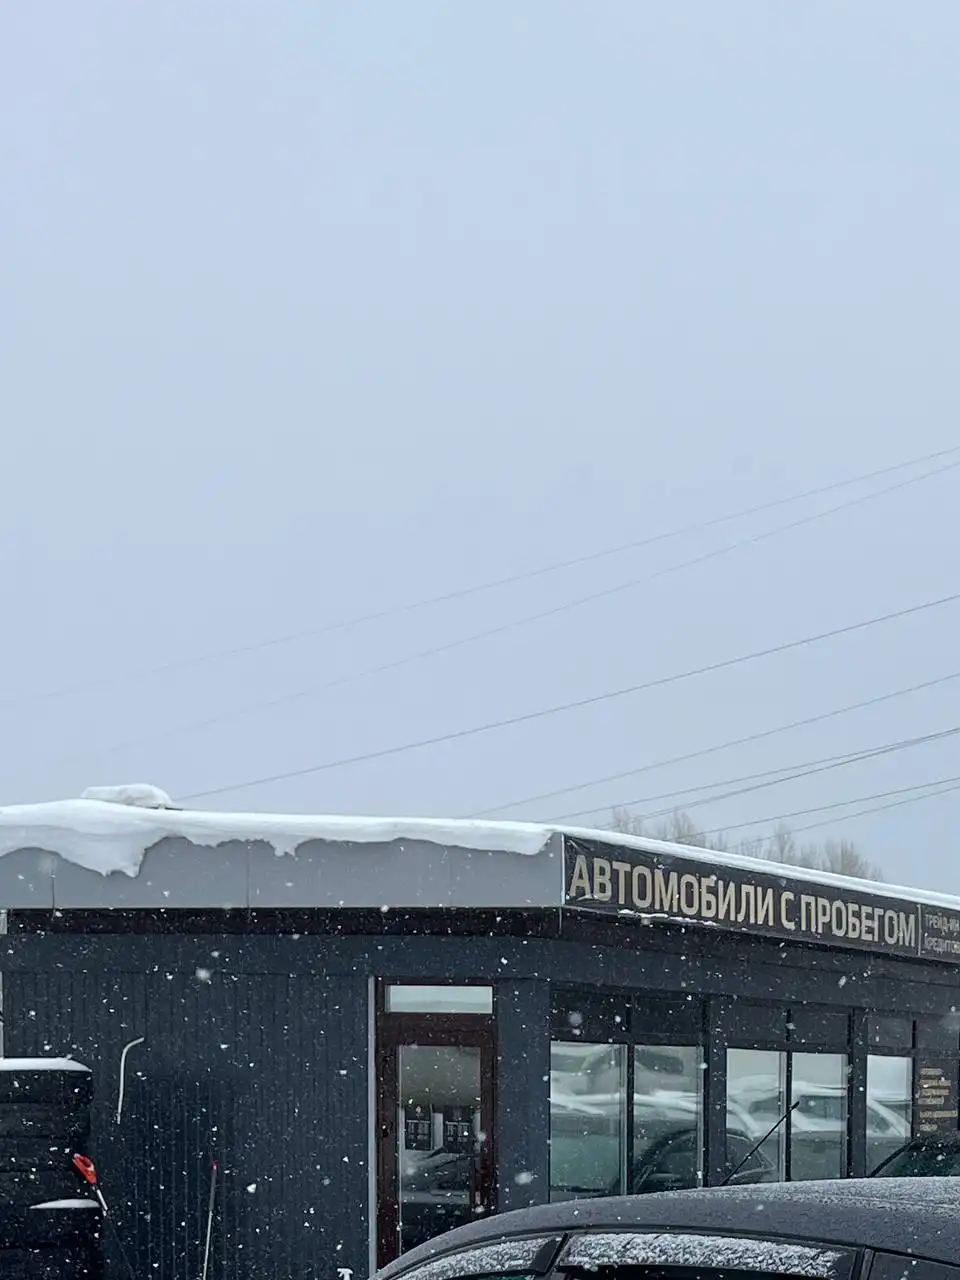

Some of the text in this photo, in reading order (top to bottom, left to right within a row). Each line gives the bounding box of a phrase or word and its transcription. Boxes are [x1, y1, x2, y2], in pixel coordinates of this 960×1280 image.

[568, 855, 916, 948] АВТОМОБИЛИ С ПРОБЕГОМ
